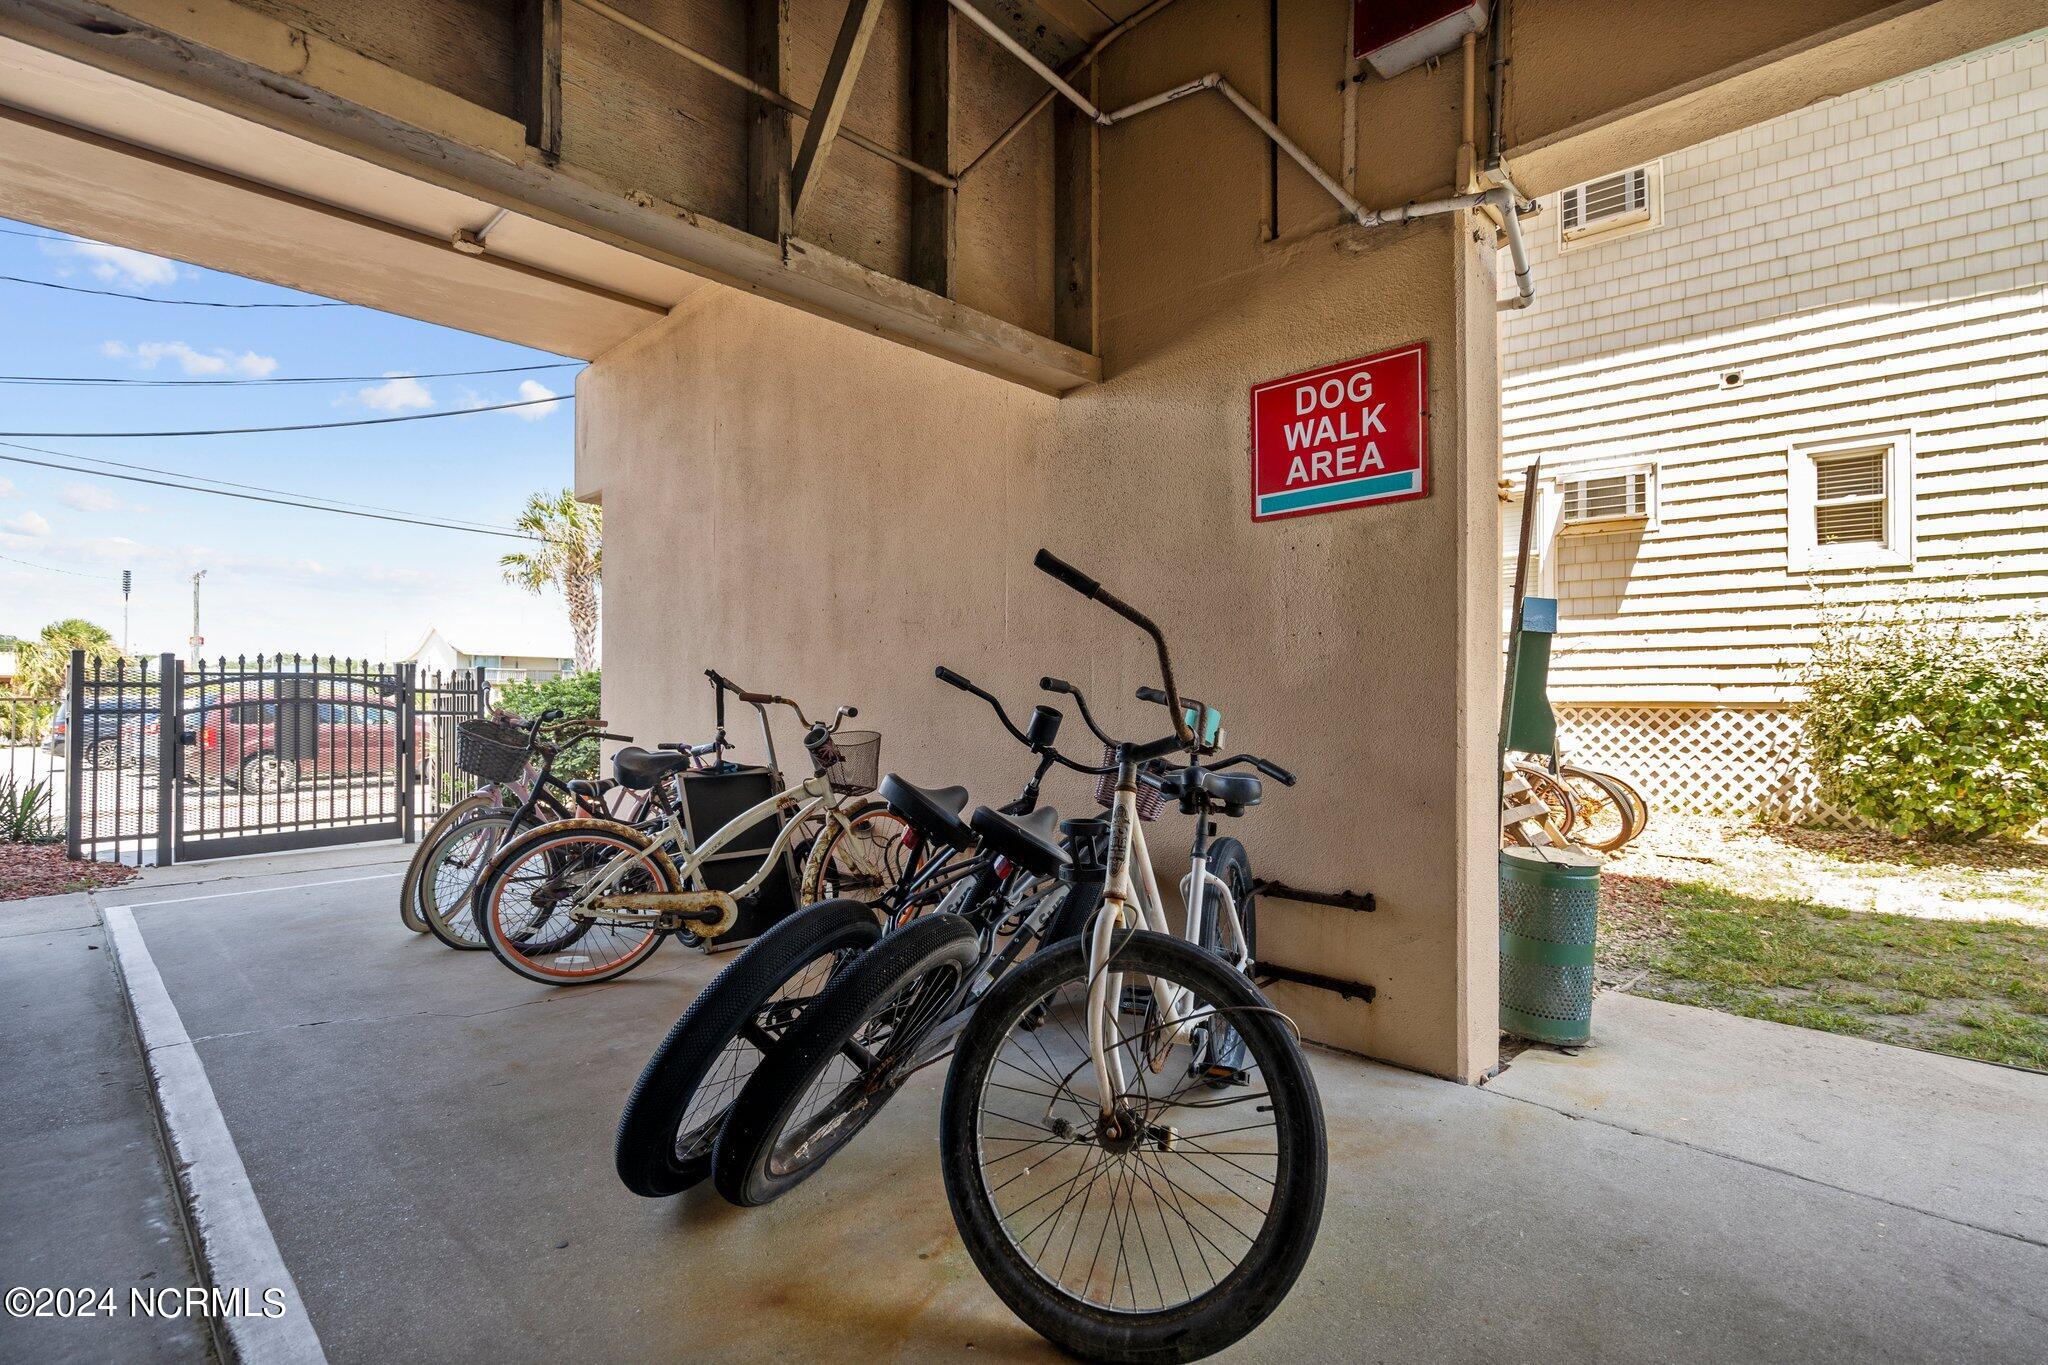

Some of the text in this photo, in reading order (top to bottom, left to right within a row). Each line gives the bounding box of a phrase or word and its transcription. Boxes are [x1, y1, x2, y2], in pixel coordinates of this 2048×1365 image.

[1296, 371, 1373, 416] DOG
[1283, 402, 1387, 452] WALK
[1285, 441, 1385, 486] AREA
